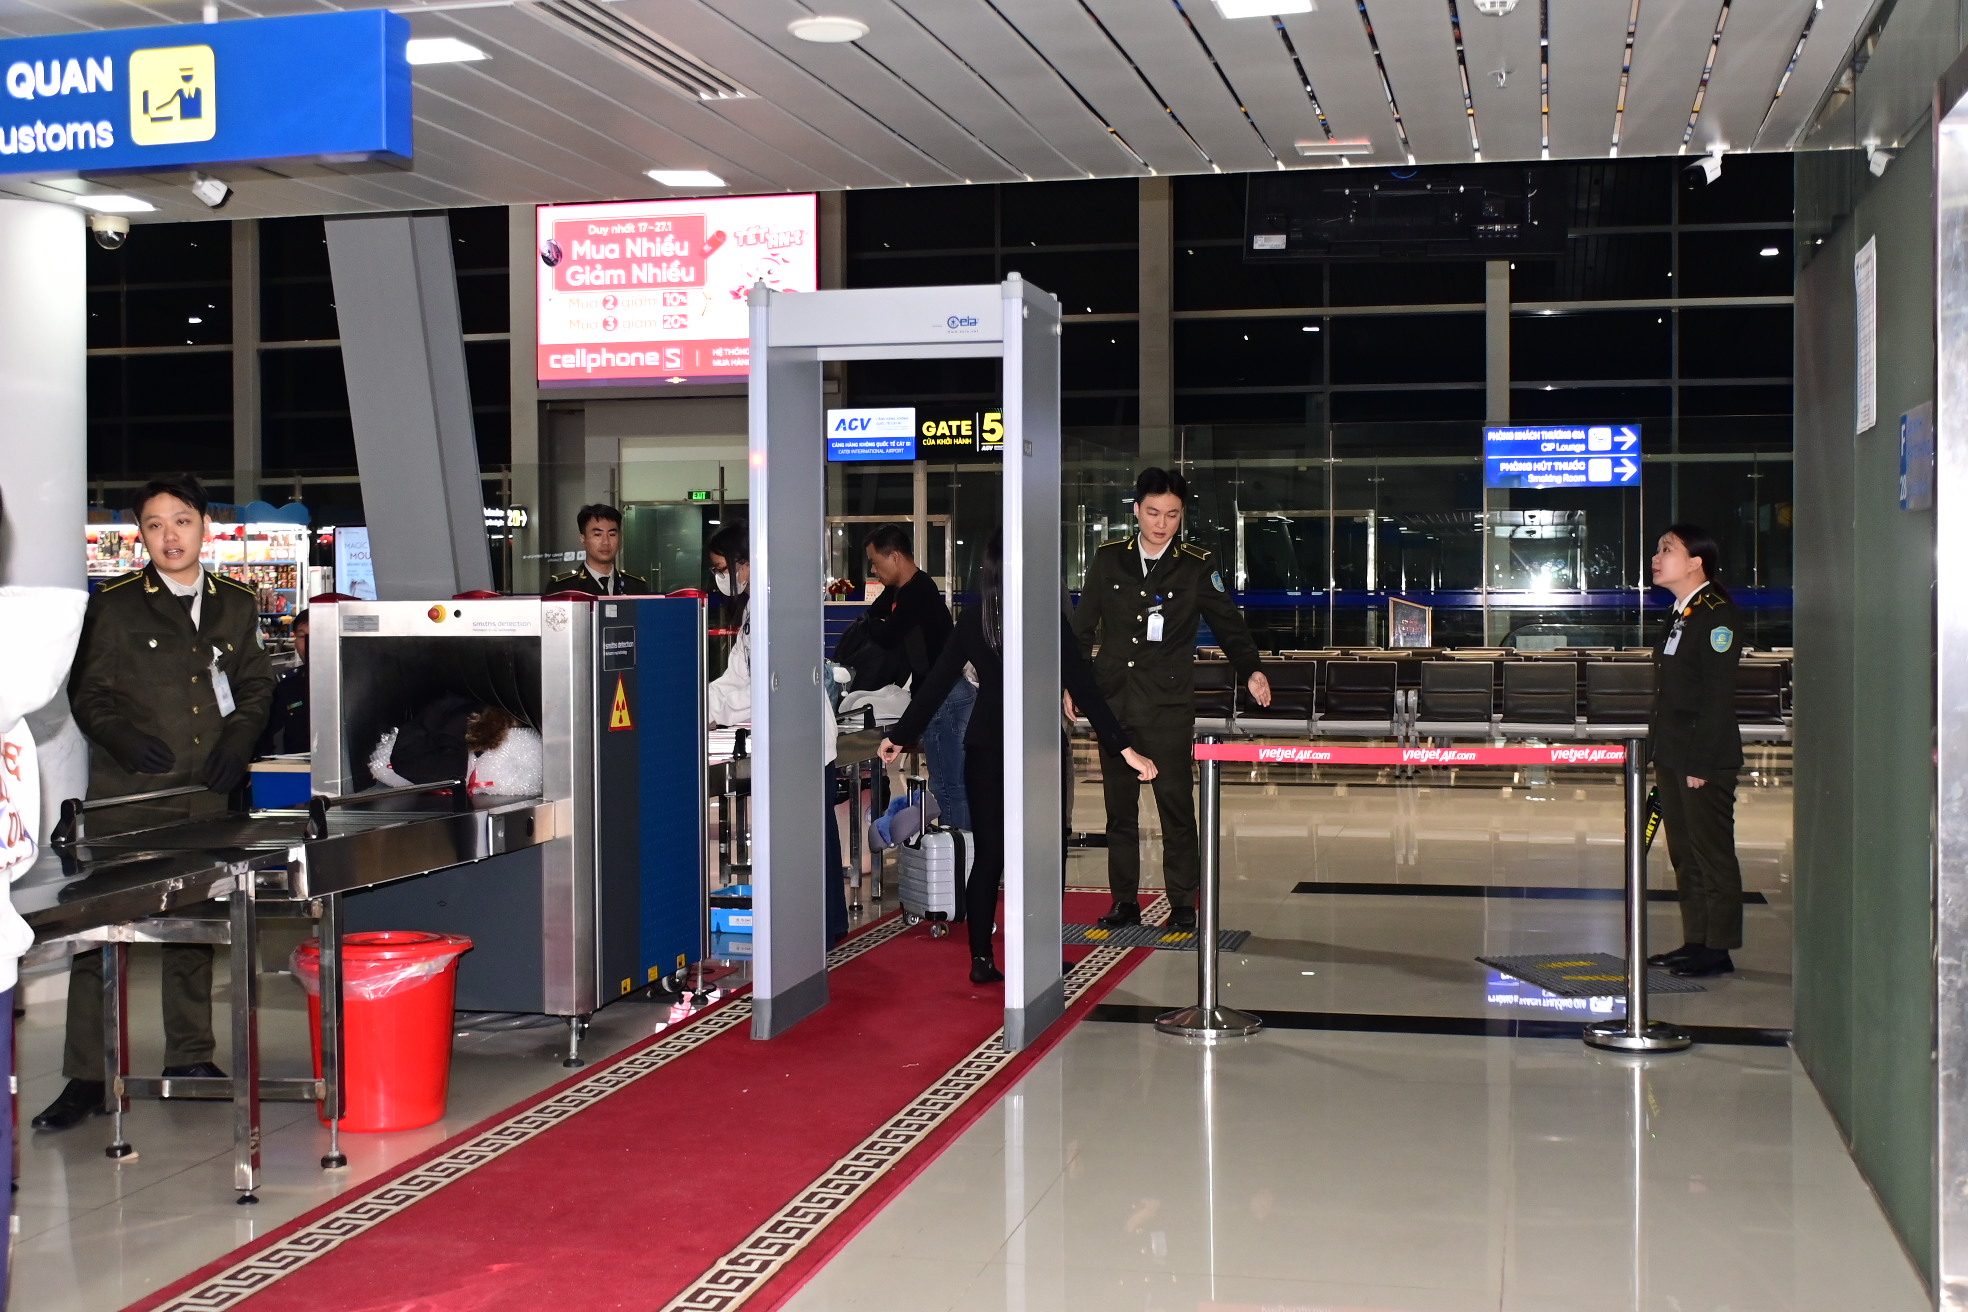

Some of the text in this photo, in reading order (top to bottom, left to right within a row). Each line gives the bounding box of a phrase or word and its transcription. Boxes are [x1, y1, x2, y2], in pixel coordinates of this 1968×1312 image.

[6, 56, 113, 100] QUAN
[0, 120, 114, 154] ustoms
[588, 225, 609, 236] Duy
[611, 222, 635, 234] nhất
[572, 233, 689, 260] Mua Nhiều
[565, 259, 695, 287] Giảm Nhiều
[568, 297, 598, 309] Mua
[604, 295, 615, 310] 2
[569, 318, 599, 330] Mua
[604, 315, 615, 331] 3
[835, 417, 872, 432] ACV
[922, 412, 1004, 442] GATE 5
[954, 437, 972, 445] HÀNH
[1488, 430, 1514, 441] PHÒNG
[1541, 442, 1585, 453] CIP Lounge
[1500, 460, 1532, 471] PHÒNG
[1533, 460, 1553, 471] HÚT
[1528, 473, 1586, 484] Smoking Room
[693, 491, 706, 500] EXIT
